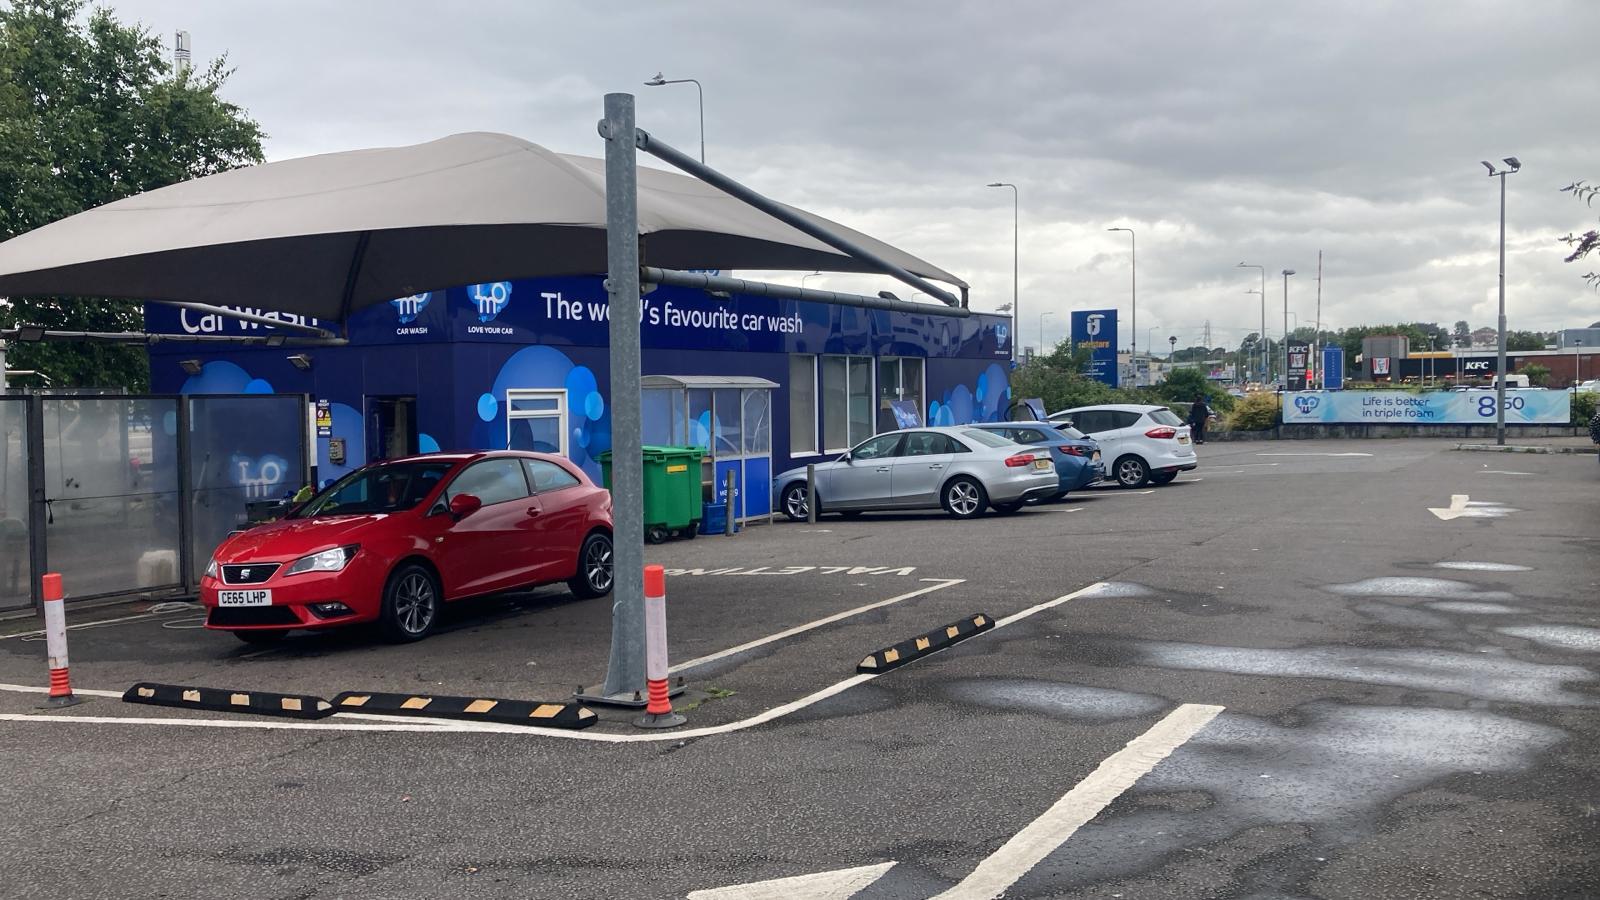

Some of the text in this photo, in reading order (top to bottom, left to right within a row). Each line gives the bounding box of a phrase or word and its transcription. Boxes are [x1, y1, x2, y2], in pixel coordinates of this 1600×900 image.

[541, 292, 583, 320] The
[665, 301, 738, 330] favourite
[742, 313, 764, 331] car
[767, 312, 803, 333] wash
[1465, 361, 1489, 370] KFC
[1362, 396, 1430, 406] Life is better
[1362, 408, 1434, 419] in triple foam
[221, 591, 266, 604] CE65 LHP
